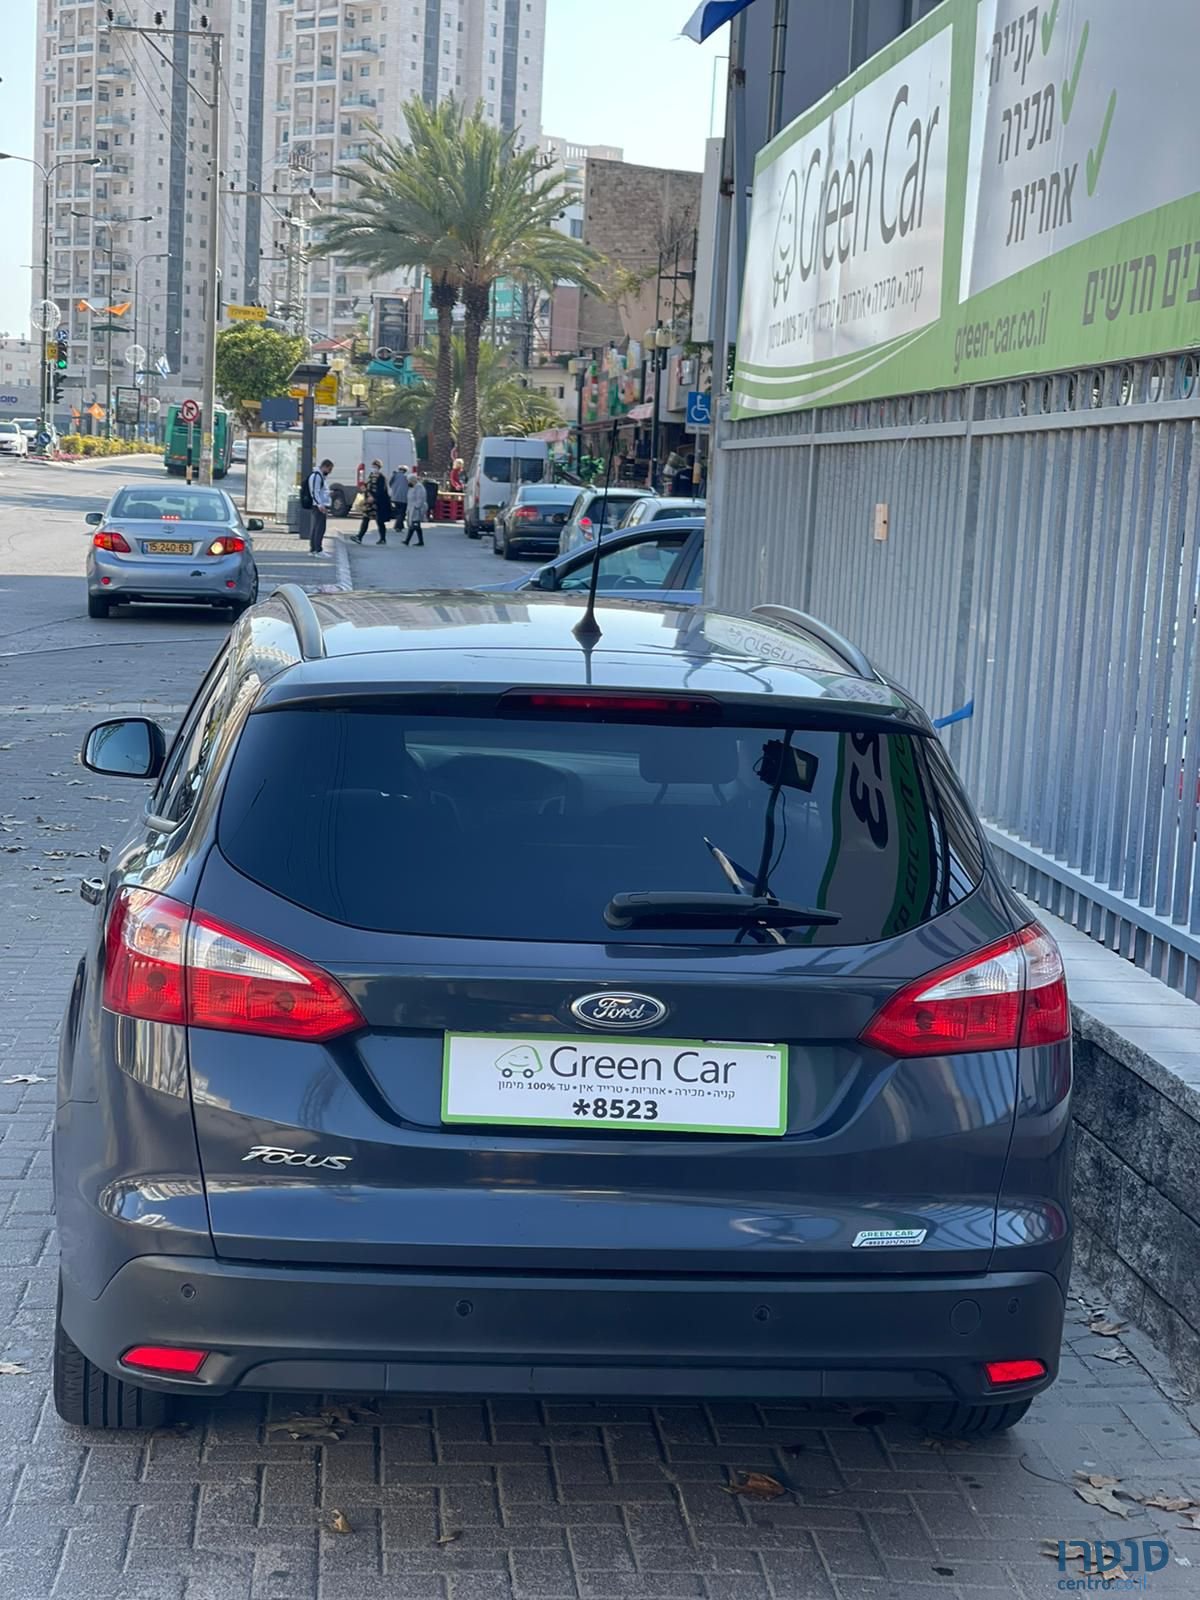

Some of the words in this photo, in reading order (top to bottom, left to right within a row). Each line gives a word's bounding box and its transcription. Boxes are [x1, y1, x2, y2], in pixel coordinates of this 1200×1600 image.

[989, 6, 1038, 86] קנייה
[998, 83, 1055, 164] מכירה
[800, 147, 873, 282] Green
[880, 84, 939, 244] Car
[1006, 163, 1078, 247] אחריות
[1082, 254, 1156, 326] חדשים
[954, 290, 1050, 374] green-car.co.il
[592, 997, 645, 1019] Ford
[549, 1046, 662, 1081] Green
[673, 1051, 737, 1084] Car
[498, 1080, 524, 1091] מימון
[527, 1082, 556, 1091] 100%
[557, 1082, 570, 1091] עד
[579, 1084, 594, 1094] אין
[597, 1084, 623, 1094] טרייד
[631, 1086, 666, 1095] אחריות
[675, 1088, 705, 1097] מכירה
[713, 1090, 736, 1100] קניה
